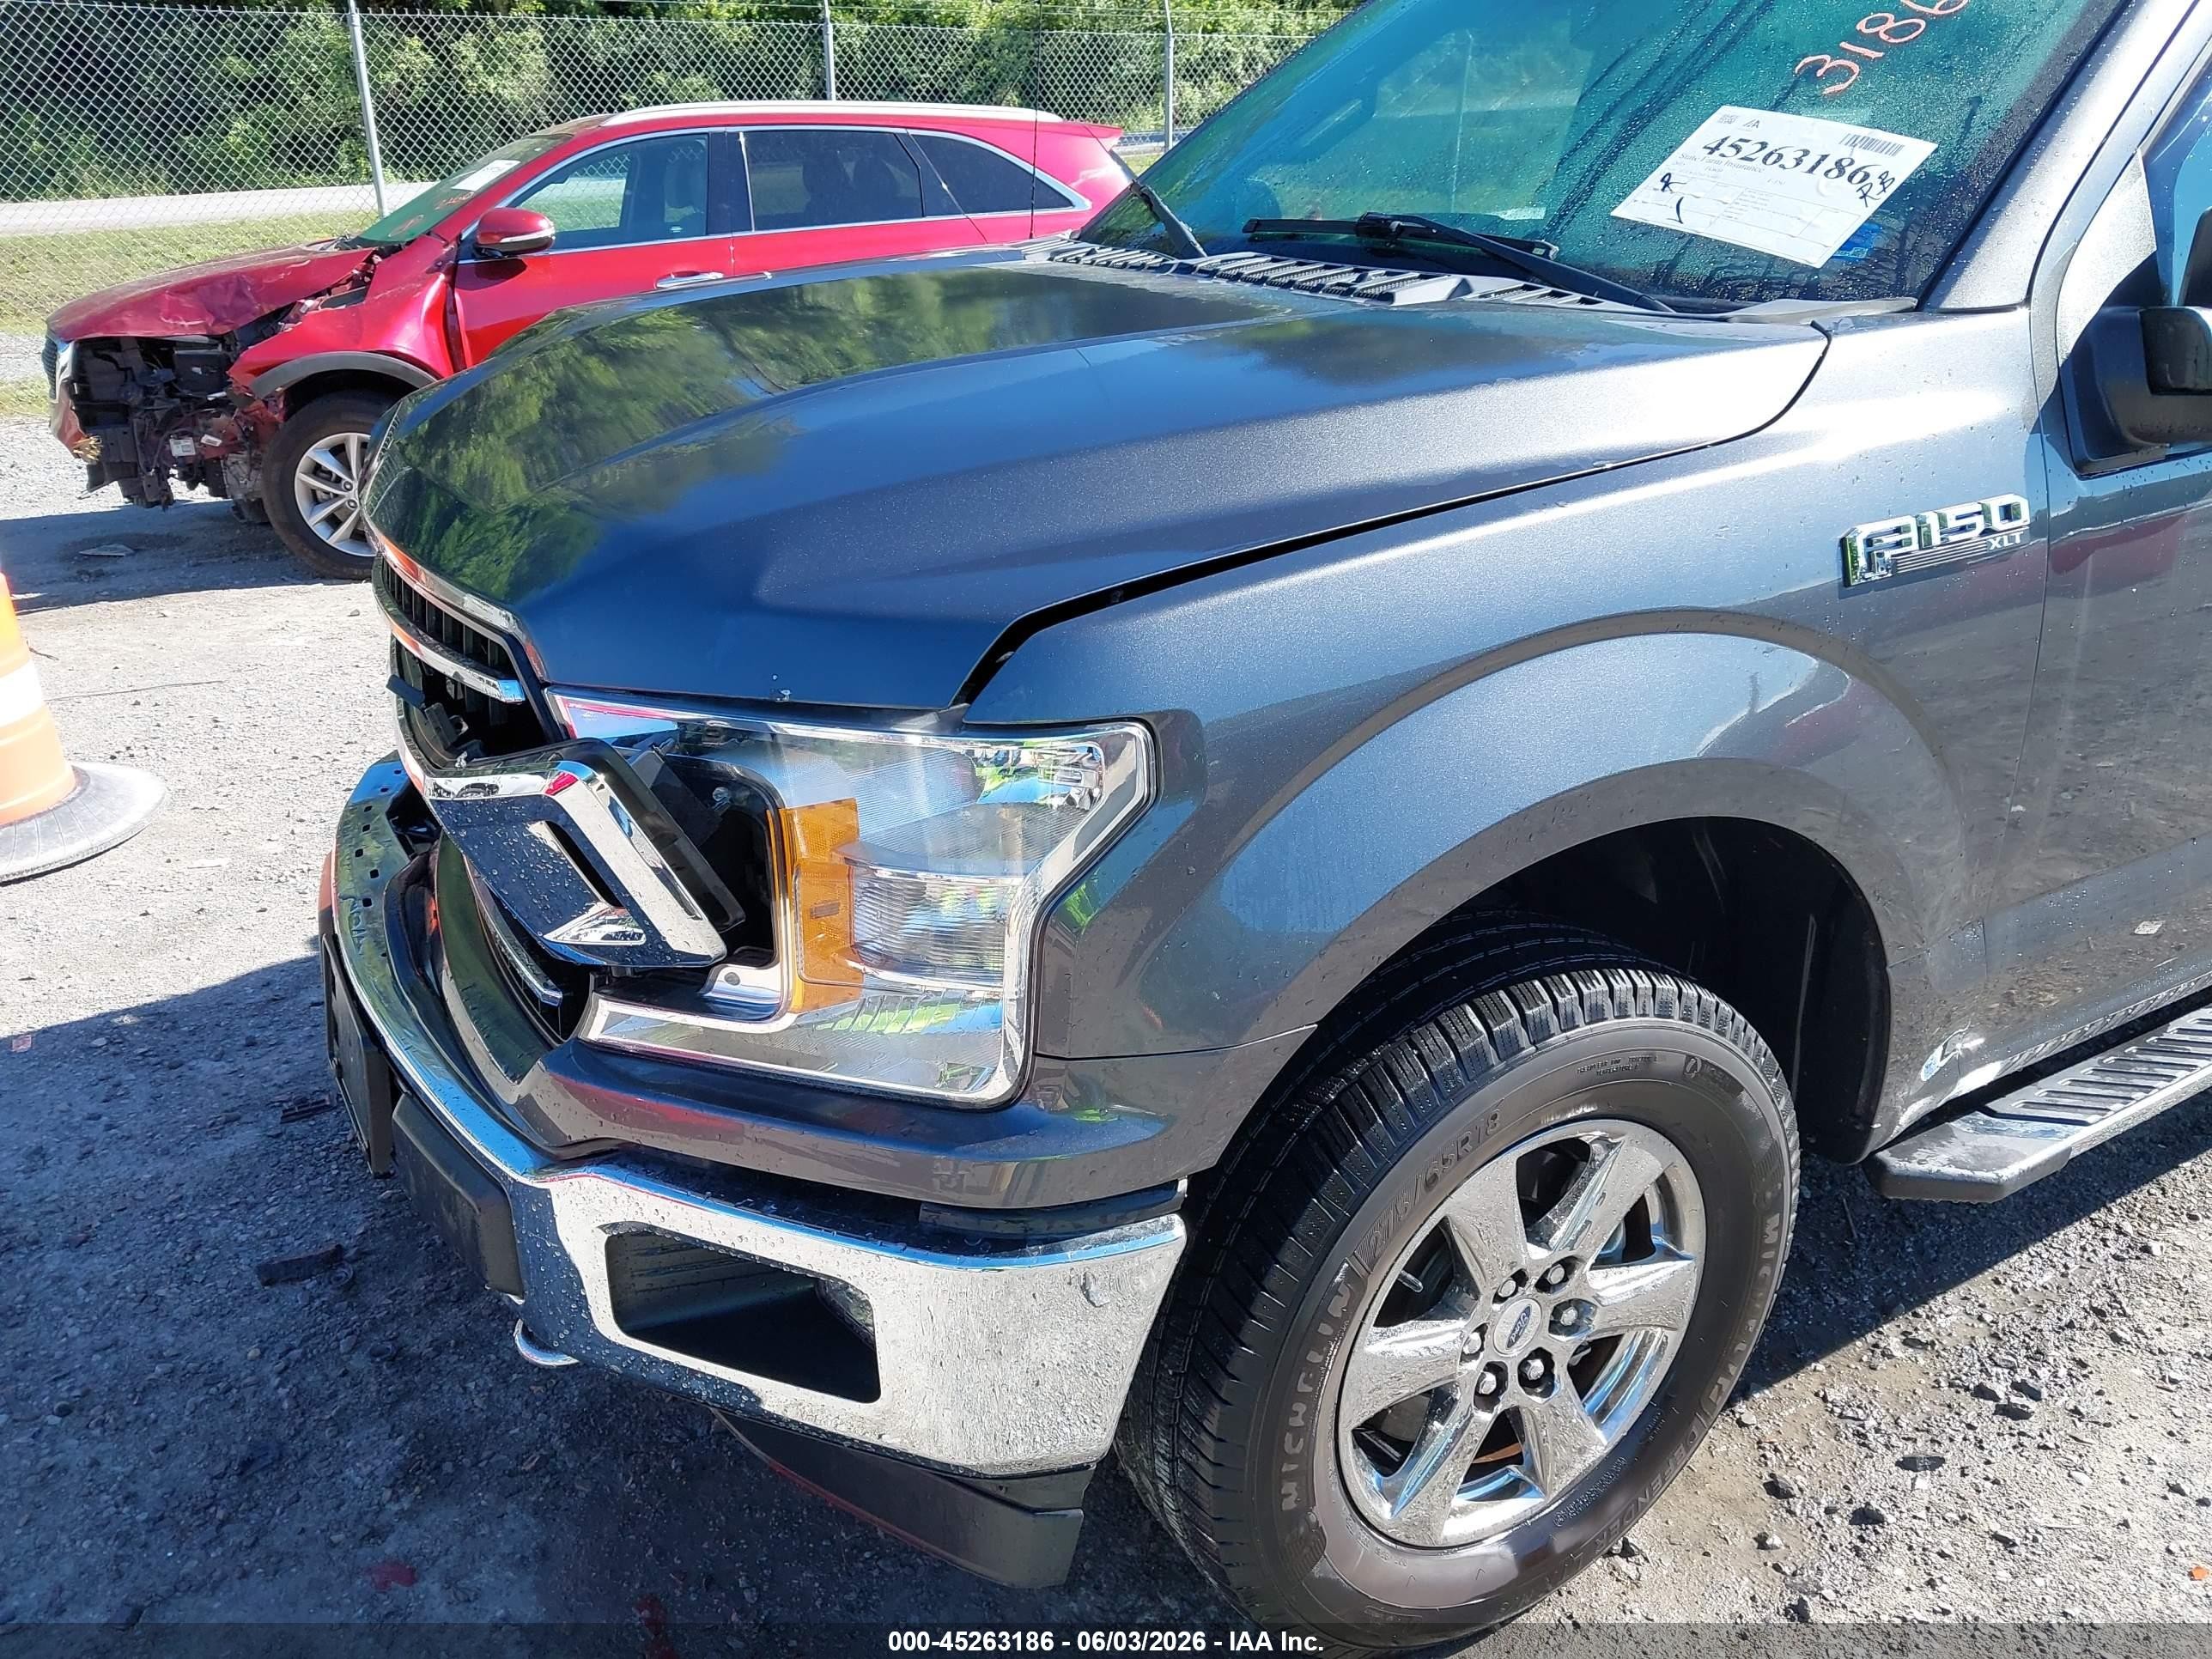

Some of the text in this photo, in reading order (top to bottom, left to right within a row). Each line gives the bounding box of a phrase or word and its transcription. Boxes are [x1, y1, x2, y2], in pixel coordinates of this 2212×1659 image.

[1703, 135, 1881, 185] 45263186
[1988, 531, 2024, 551] XLT
[1280, 1281, 1352, 1511] MICHELIN
[1595, 1429, 1699, 1554] DEFENDER
